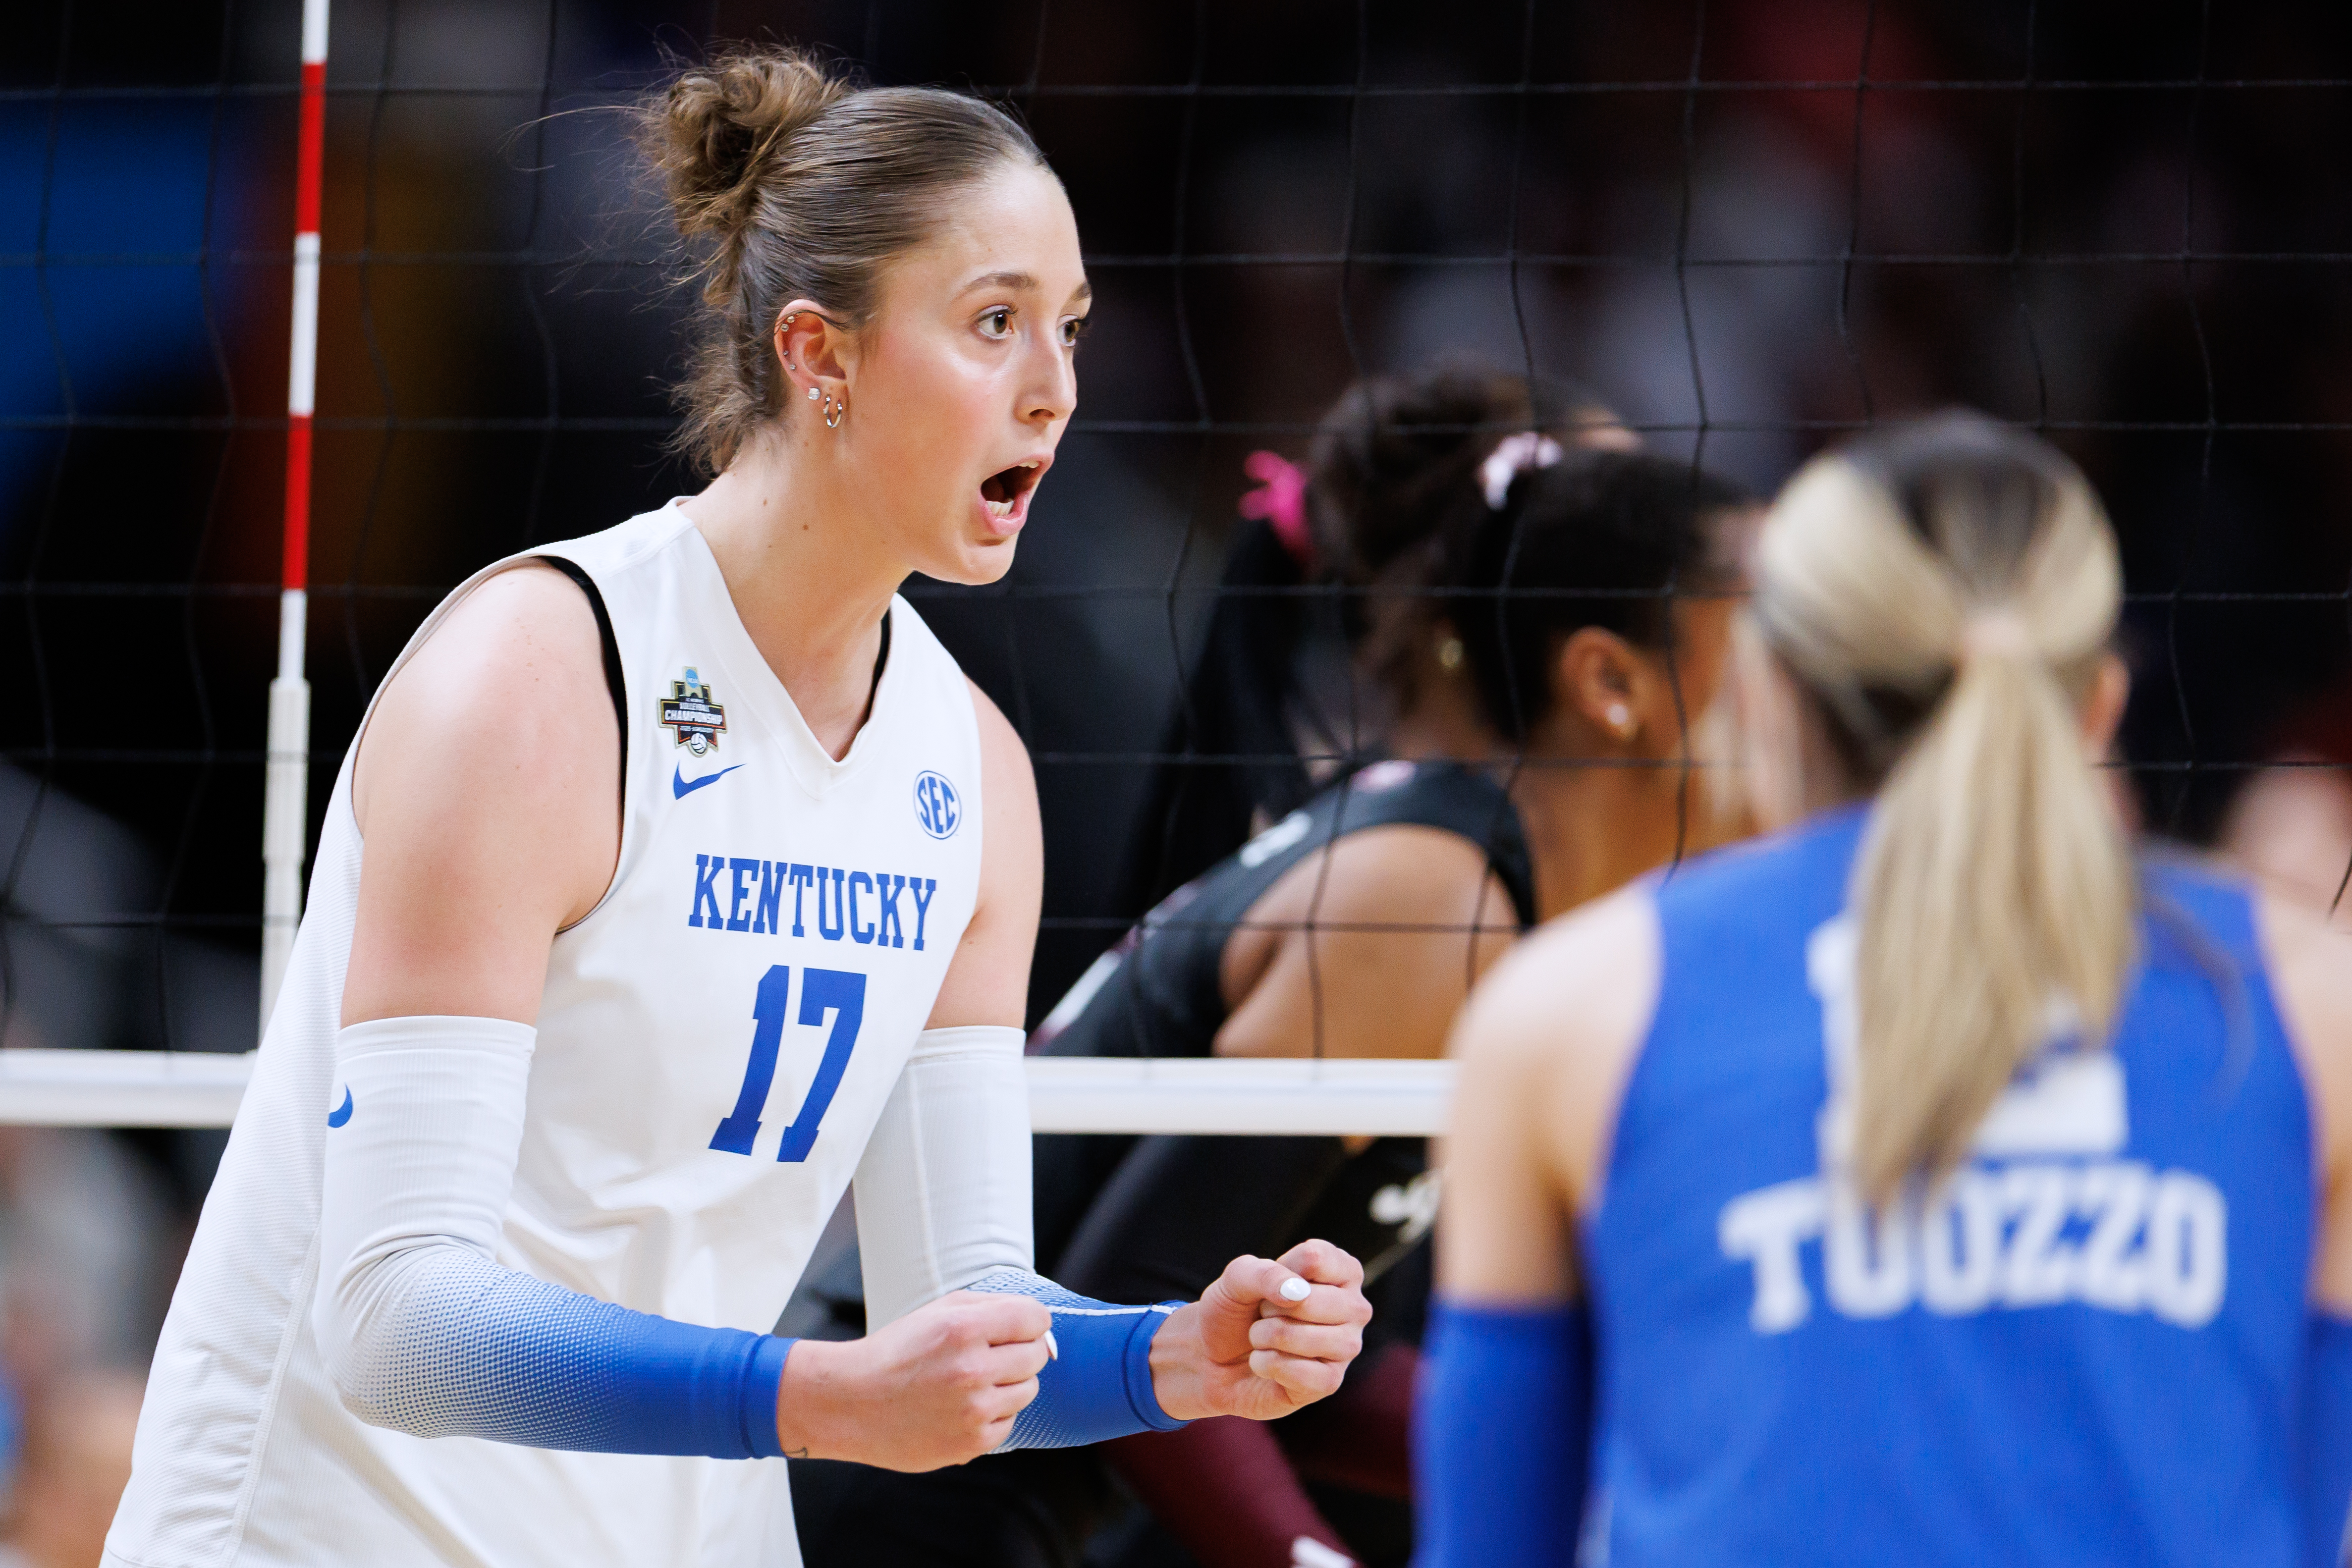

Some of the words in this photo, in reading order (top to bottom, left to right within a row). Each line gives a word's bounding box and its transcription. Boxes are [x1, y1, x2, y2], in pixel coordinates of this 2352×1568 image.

[917, 776, 956, 834] SEC
[688, 854, 937, 951] KENTUCKY
[708, 964, 867, 1163] 17
[1717, 1159, 2228, 1336] TUOZZO
